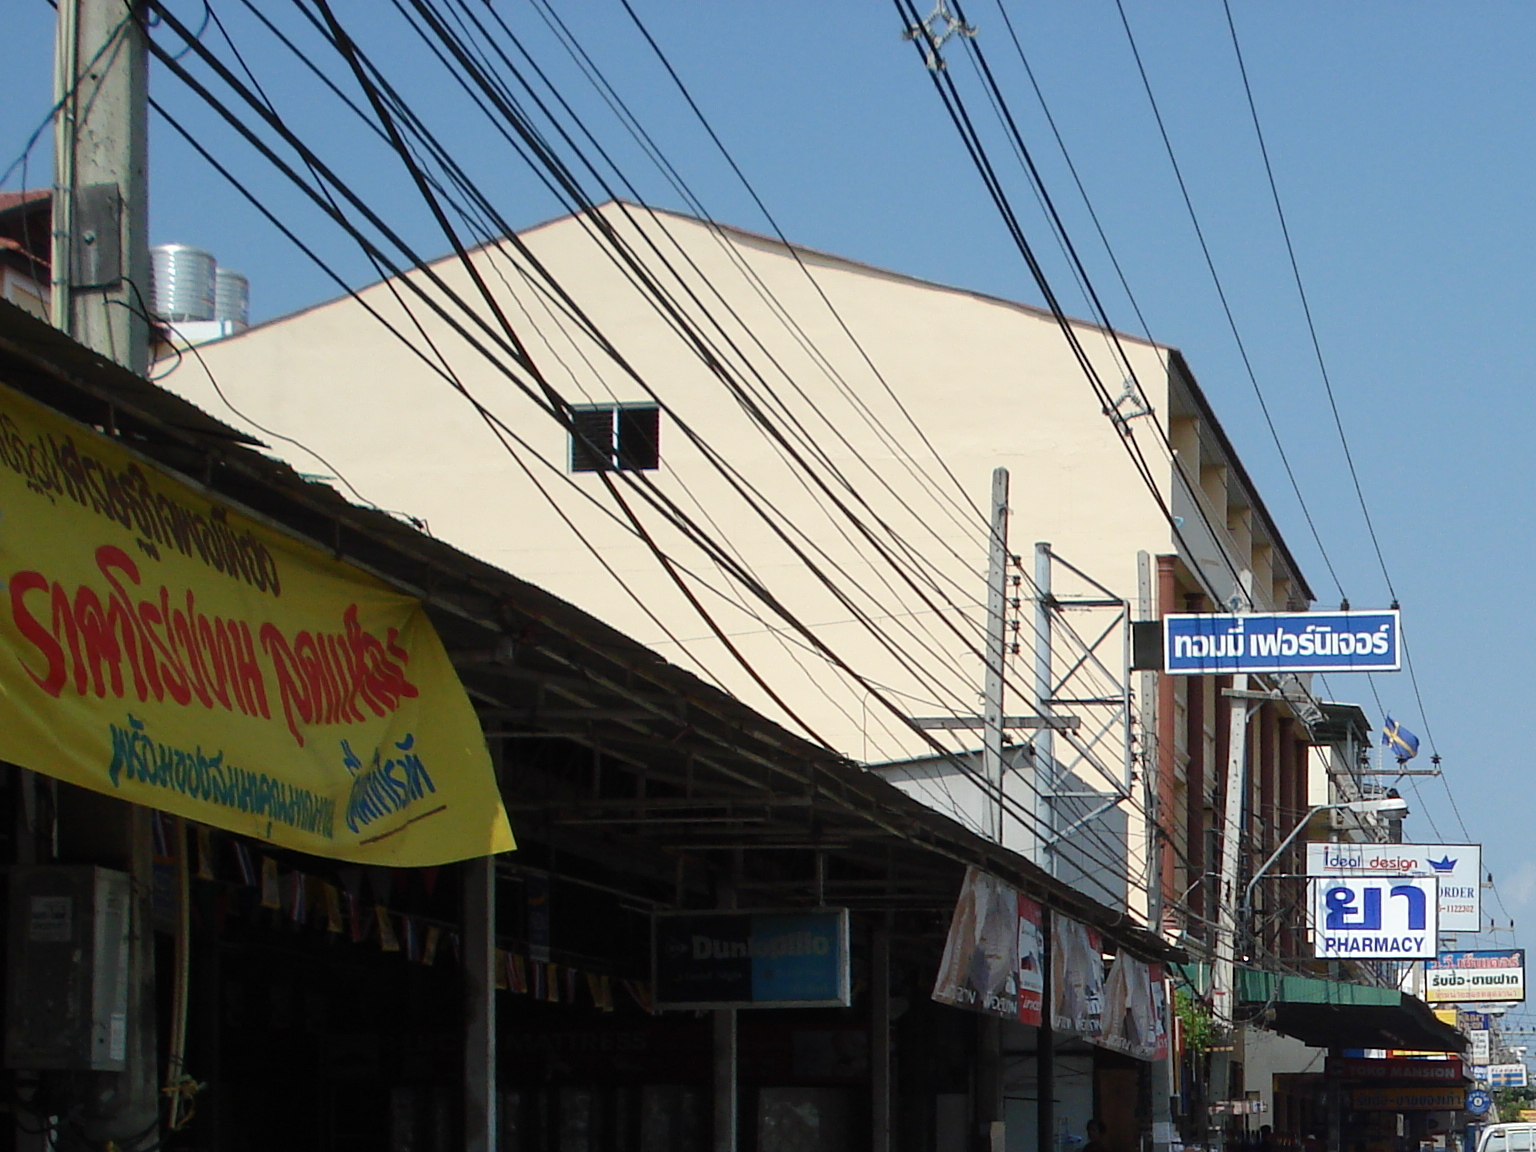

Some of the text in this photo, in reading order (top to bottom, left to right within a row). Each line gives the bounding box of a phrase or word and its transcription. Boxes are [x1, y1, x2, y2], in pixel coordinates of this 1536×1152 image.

[1250, 623, 1390, 659] เฟอร์นิเจอร์
[1369, 855, 1418, 872] design
[1325, 885, 1427, 931] ยา
[1325, 936, 1425, 953] PHARMACY
[1390, 1066, 1455, 1079] MANSION
